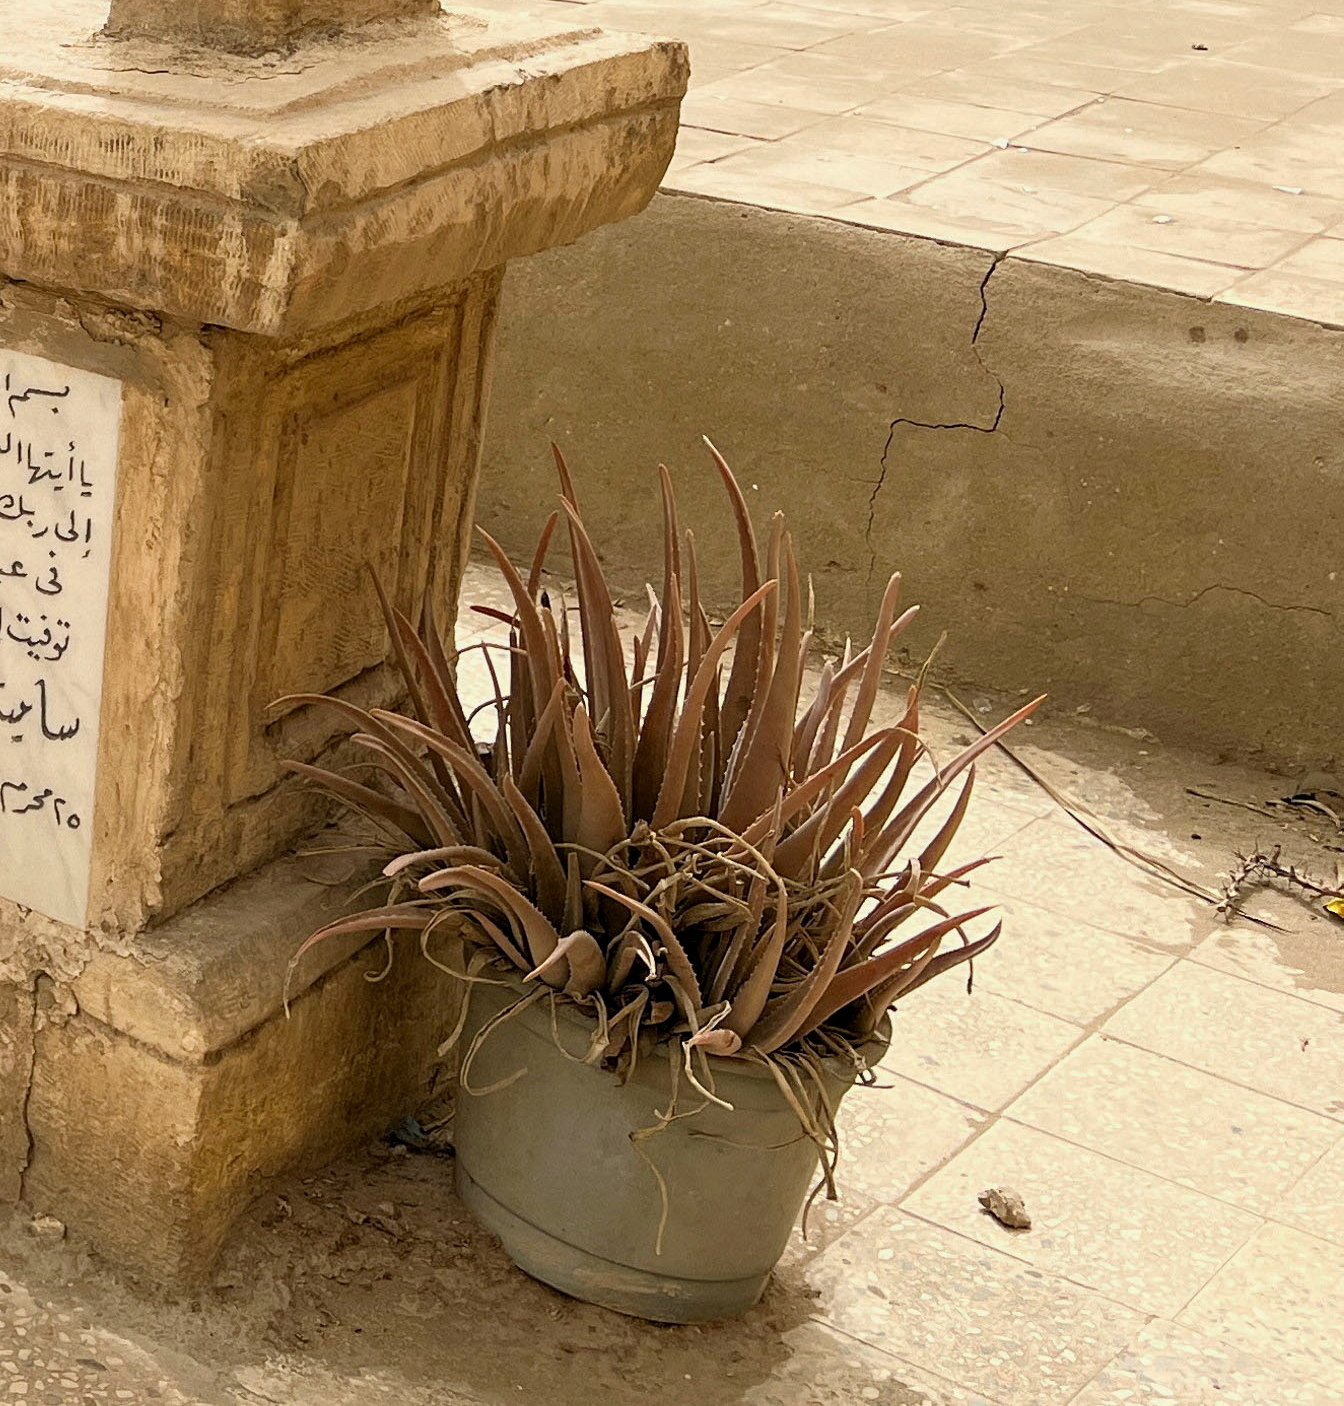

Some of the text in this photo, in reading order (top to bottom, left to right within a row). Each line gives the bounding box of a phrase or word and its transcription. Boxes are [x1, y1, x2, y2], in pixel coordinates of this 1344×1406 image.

[8, 385, 70, 418] بسم
[6, 612, 72, 661] توفيت
[0, 781, 53, 813] محرم
[53, 798, 81, 830] ٢٥
